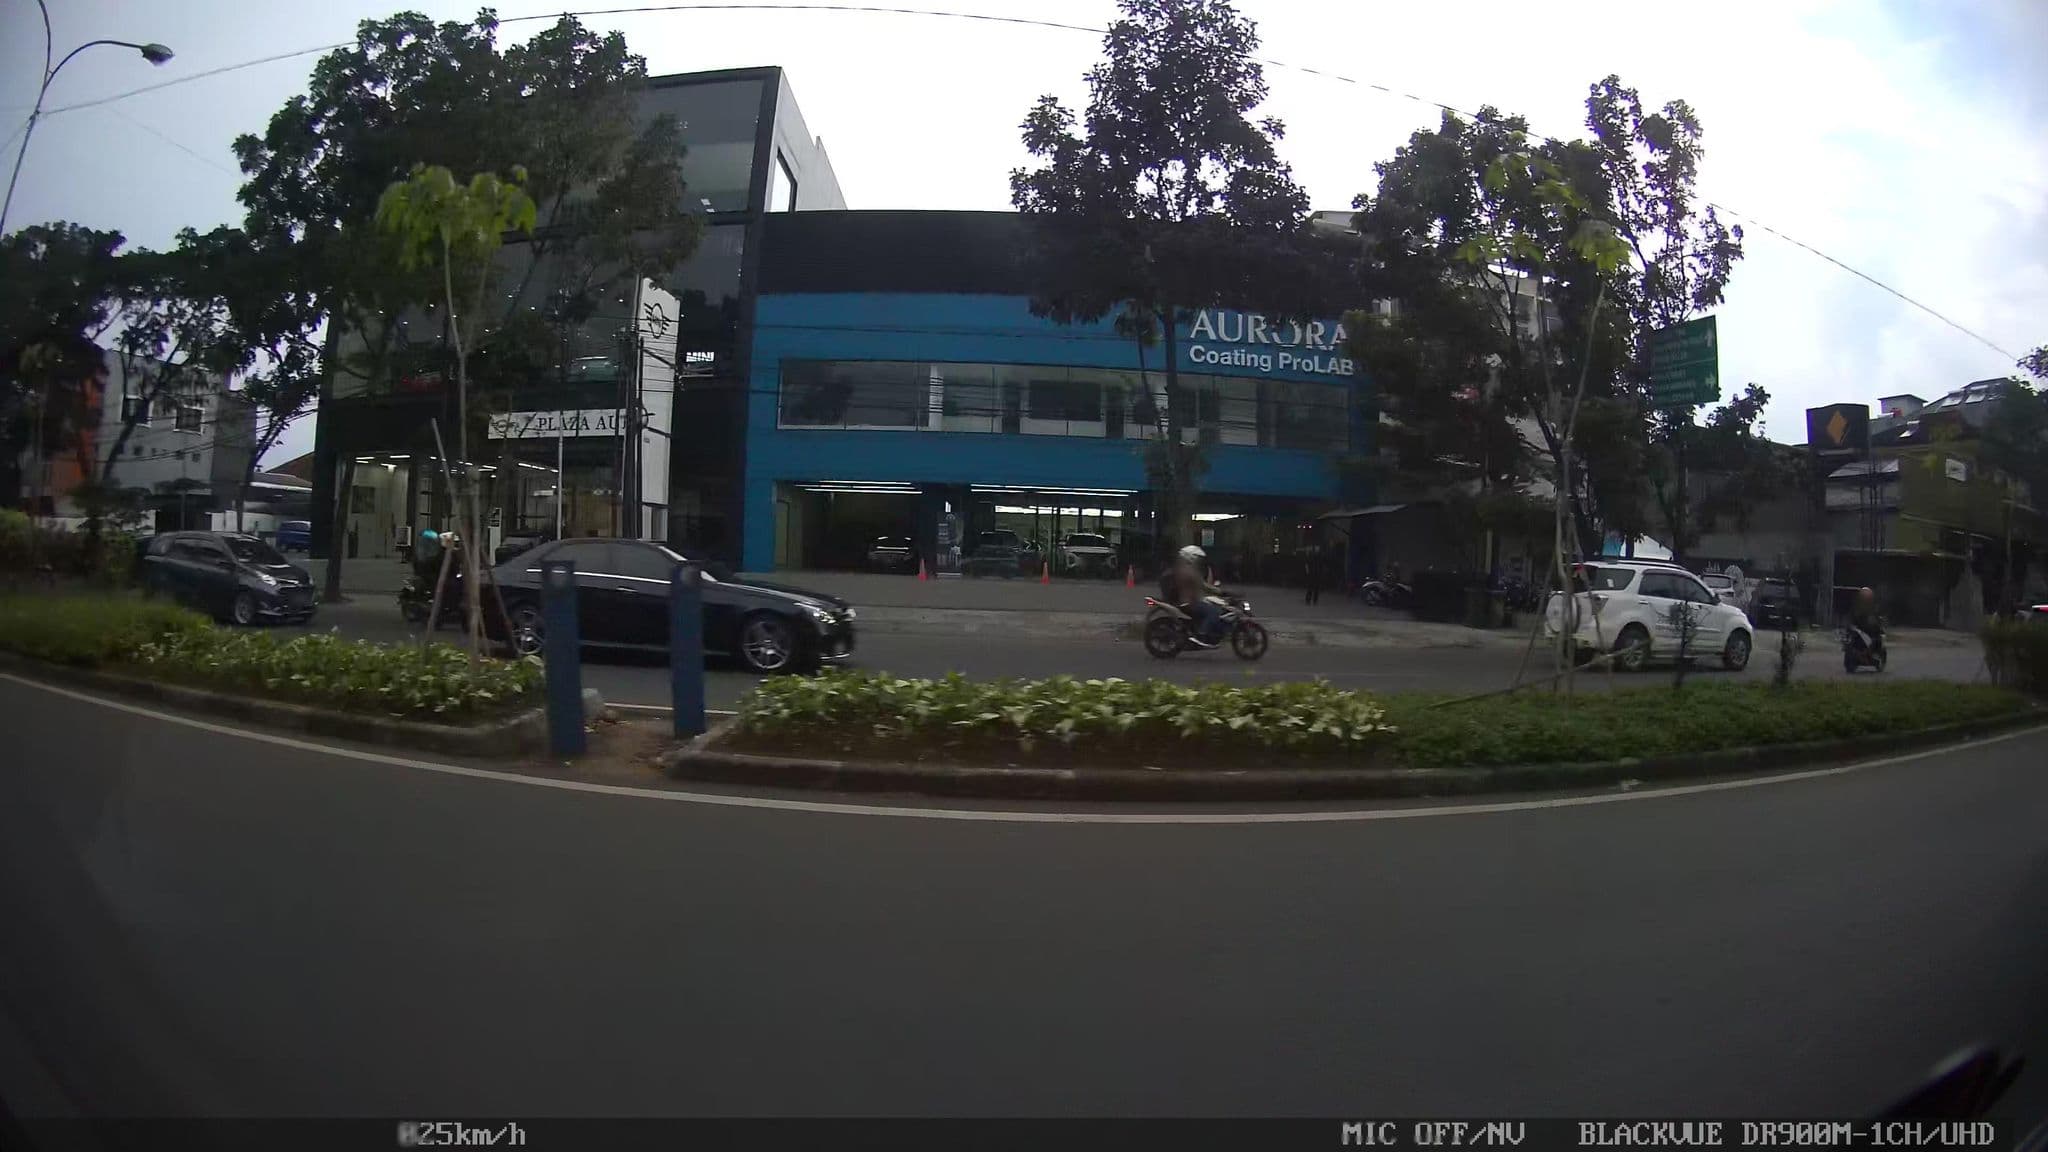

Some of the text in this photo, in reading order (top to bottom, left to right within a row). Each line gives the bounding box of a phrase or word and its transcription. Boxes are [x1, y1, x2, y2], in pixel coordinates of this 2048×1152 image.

[1189, 345, 1354, 376] Coating ProLAB
[537, 415, 627, 431] PLAZA AU
